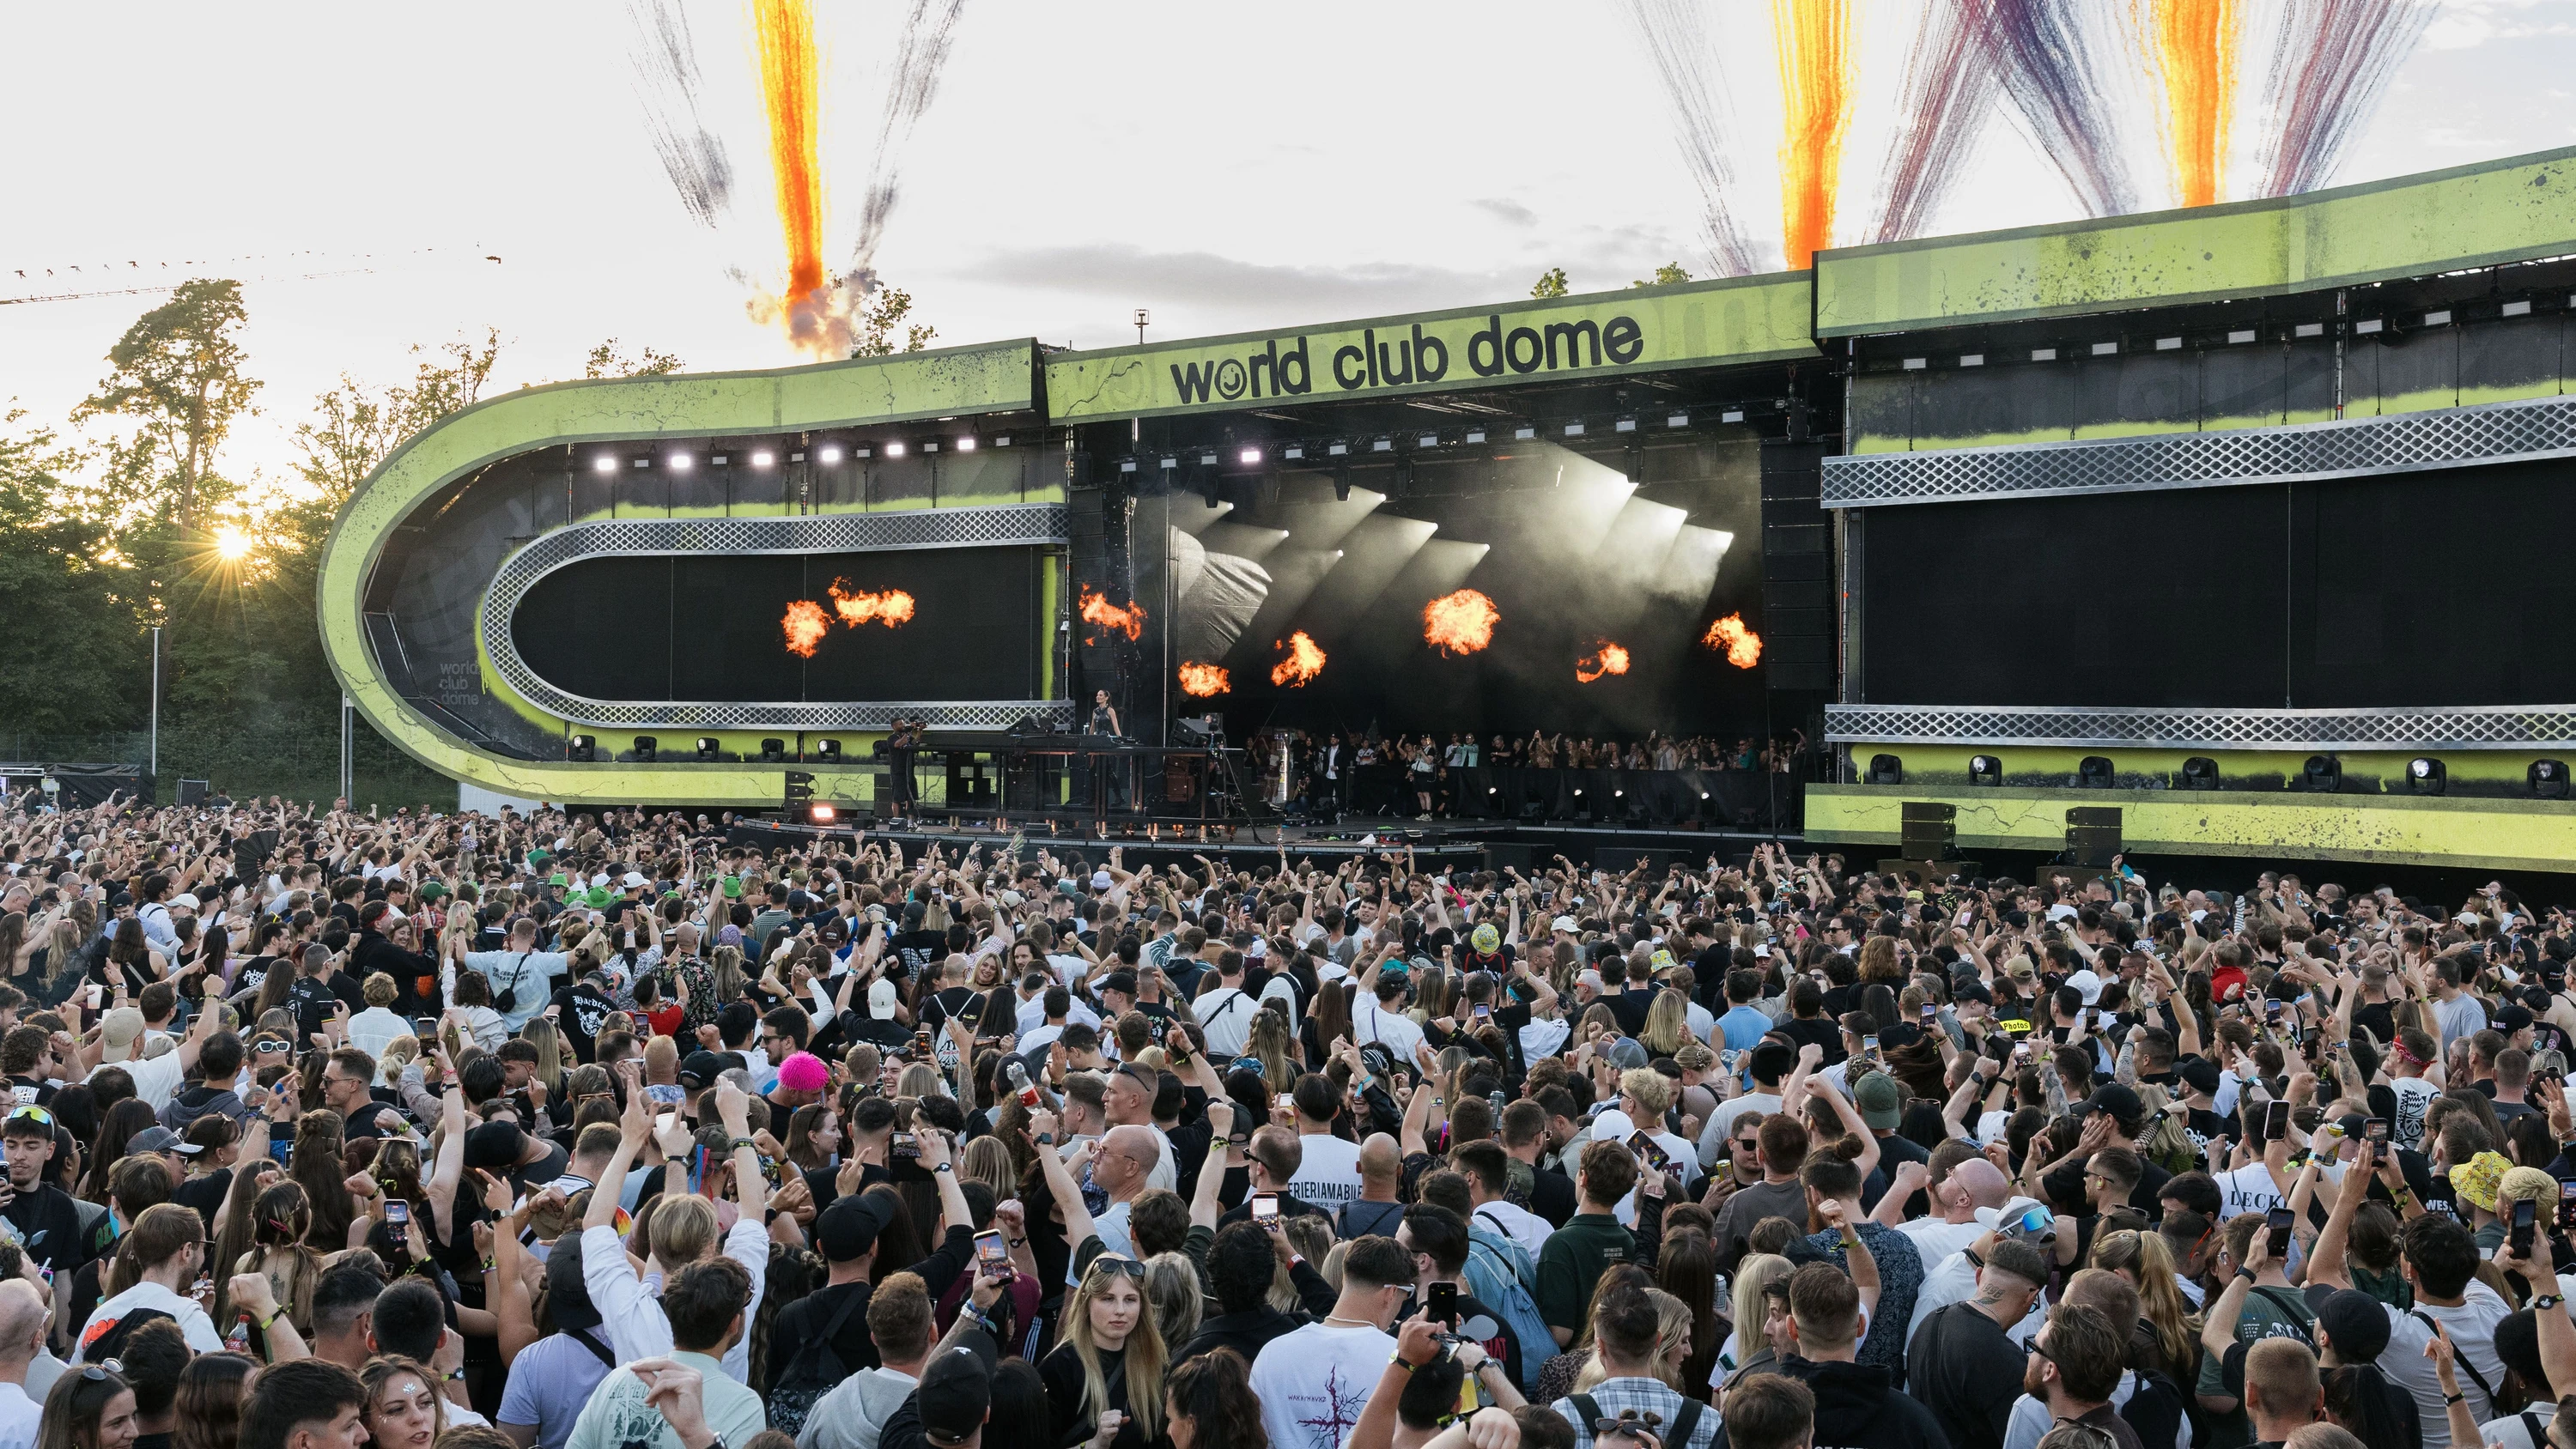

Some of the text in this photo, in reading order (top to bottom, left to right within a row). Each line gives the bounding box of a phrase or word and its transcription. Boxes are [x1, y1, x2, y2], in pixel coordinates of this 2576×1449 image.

[1170, 315, 1643, 403] world club dome
[440, 660, 478, 675] world
[439, 676, 469, 690] club
[440, 690, 479, 706] dome
[572, 995, 613, 1014] Hardcor
[2230, 1191, 2287, 1209] LECK
